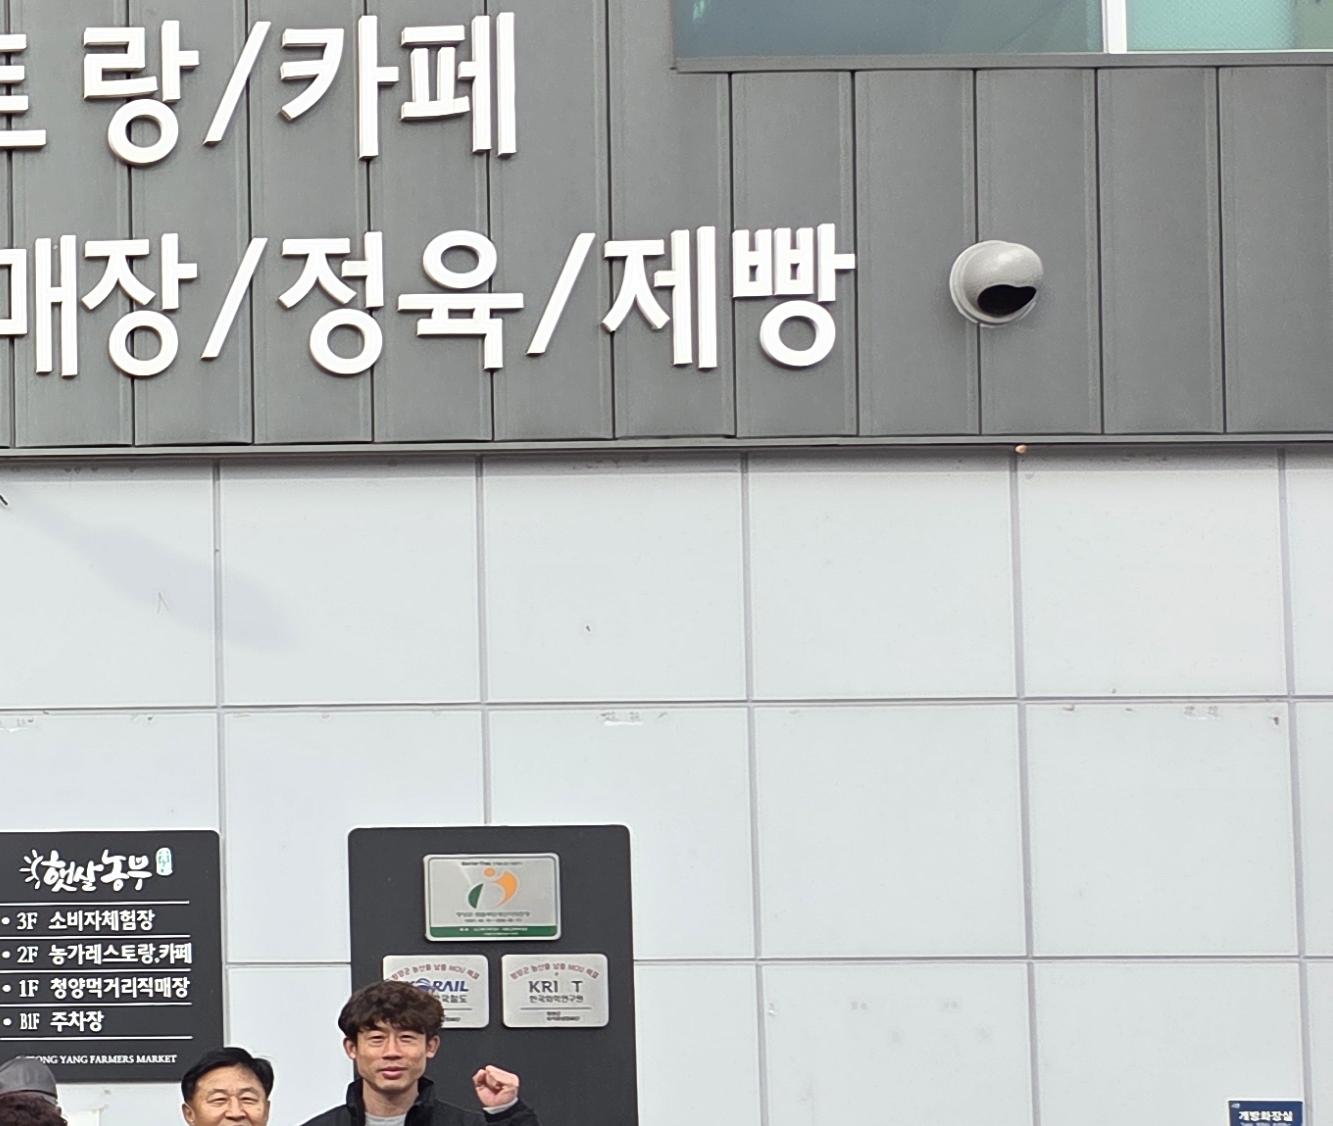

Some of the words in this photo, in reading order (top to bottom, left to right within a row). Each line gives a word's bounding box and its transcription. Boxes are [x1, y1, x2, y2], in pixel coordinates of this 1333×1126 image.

[42, 849, 153, 892] 햇살농부
[17, 911, 38, 930] 3F
[48, 910, 156, 931] 소비자체험장
[17, 945, 39, 964] 2F
[19, 980, 39, 997] 1F
[50, 977, 190, 999] 청양먹거리직매장
[20, 1013, 39, 1030] B1F
[50, 1011, 104, 1032] 주차장
[60, 1055, 88, 1065] YANG
[90, 1055, 134, 1064] FARMERS
[136, 1054, 177, 1064] MARKET
[1238, 1110, 1293, 1121] 개방화장실
